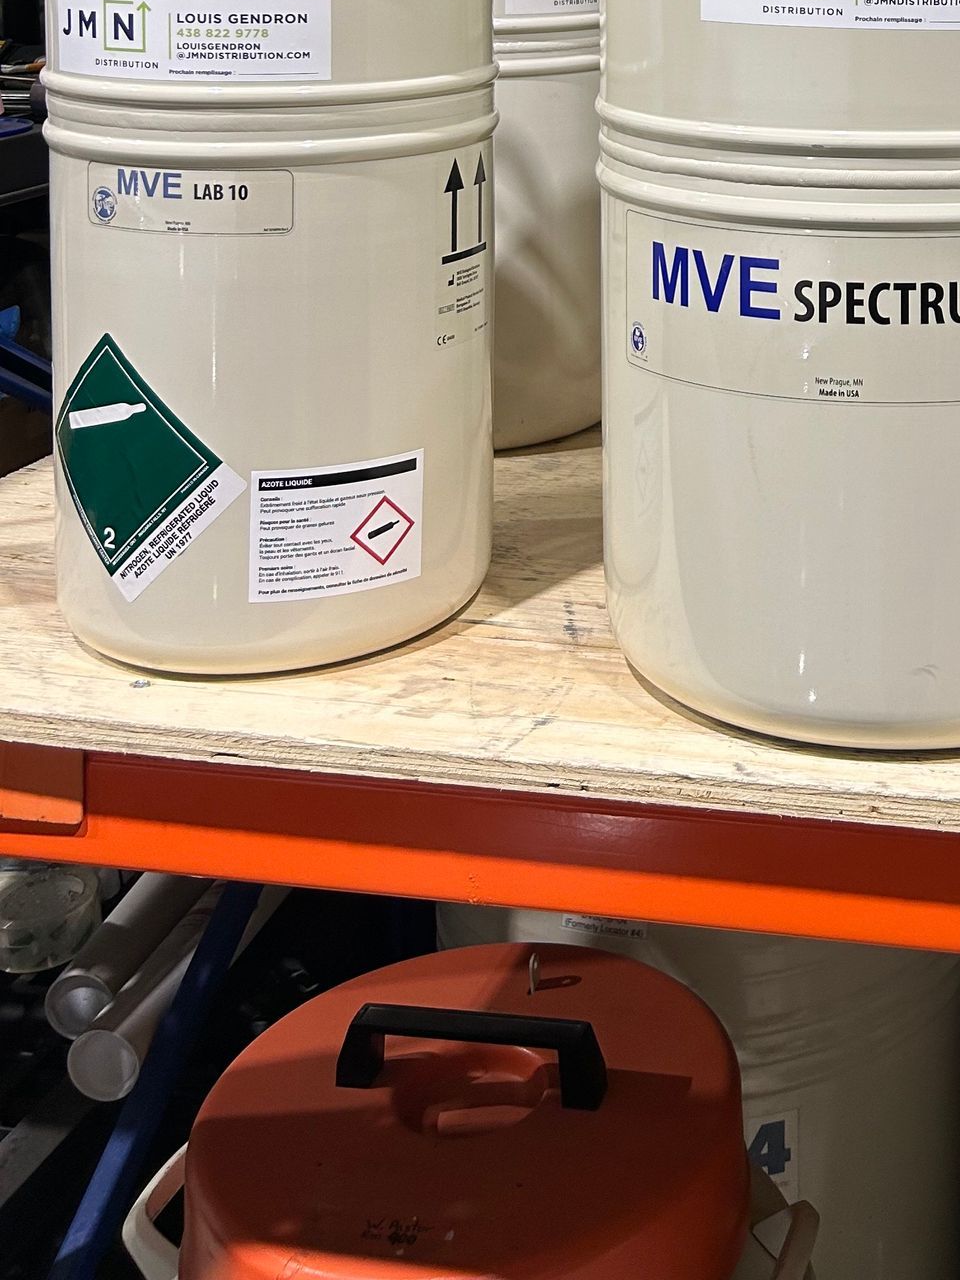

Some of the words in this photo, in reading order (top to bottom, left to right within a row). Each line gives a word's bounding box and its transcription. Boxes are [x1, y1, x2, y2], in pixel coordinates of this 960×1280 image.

[762, 5, 844, 16] DISTRIBUTION
[176, 13, 222, 24] LOUIS
[228, 13, 308, 24] GENDRON
[176, 28, 201, 38] 438
[205, 28, 230, 38] 822
[235, 28, 269, 38] 9778
[176, 43, 261, 51] LOUISGENDRON
[176, 52, 310, 60] @JMNDISTRIBUTION.COM
[95, 58, 159, 69] DISTRIBUTION
[117, 168, 182, 199] MVE
[194, 184, 223, 200] LAB
[228, 184, 248, 201] 10
[652, 240, 781, 320] MVE
[829, 378, 851, 387] Prague,
[261, 480, 284, 488] AZOTE
[285, 478, 313, 487] LIQUIDE
[119, 546, 152, 580] NITROGEN,
[150, 502, 196, 548] REFRIGERATED
[194, 479, 219, 504] LIQUID
[103, 527, 115, 548] 2
[165, 547, 177, 560] UN
[176, 532, 192, 549] 1977
[134, 556, 154, 578] AZOTE
[152, 534, 179, 558] LIQUIDE
